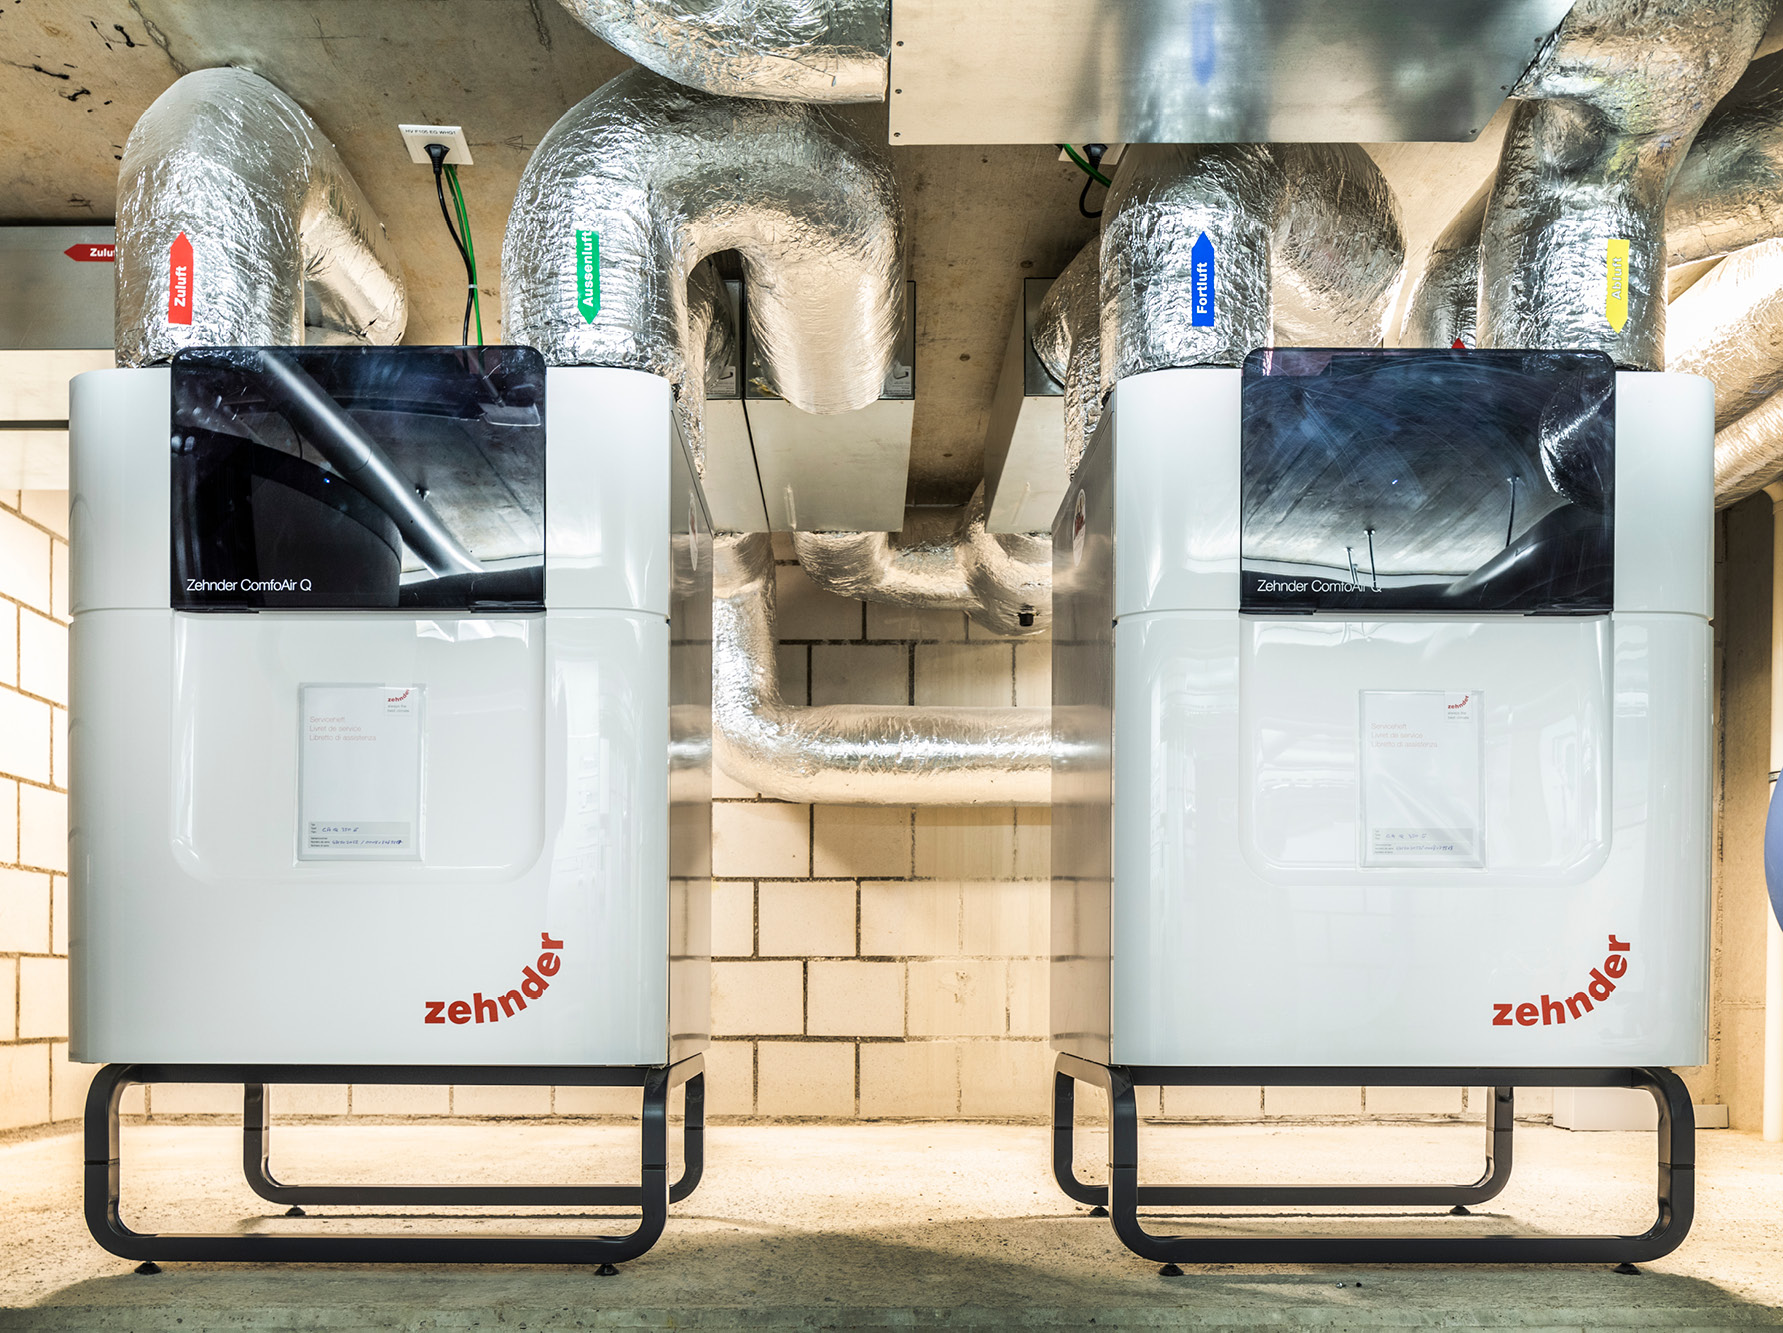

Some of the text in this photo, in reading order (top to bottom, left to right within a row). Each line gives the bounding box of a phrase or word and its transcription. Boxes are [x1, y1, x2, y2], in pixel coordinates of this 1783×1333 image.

[174, 266, 187, 307] Zuluft
[581, 229, 594, 307] Aussenluft
[1196, 262, 1208, 314] Fortluft
[1611, 256, 1622, 300] Abluft
[186, 578, 312, 592] Zehnder ComfoAir Q
[1257, 580, 1309, 592] Zehnder
[1447, 695, 1469, 709] zehnder
[425, 932, 563, 1024] zehnder
[1493, 934, 1630, 1026] zehnder
